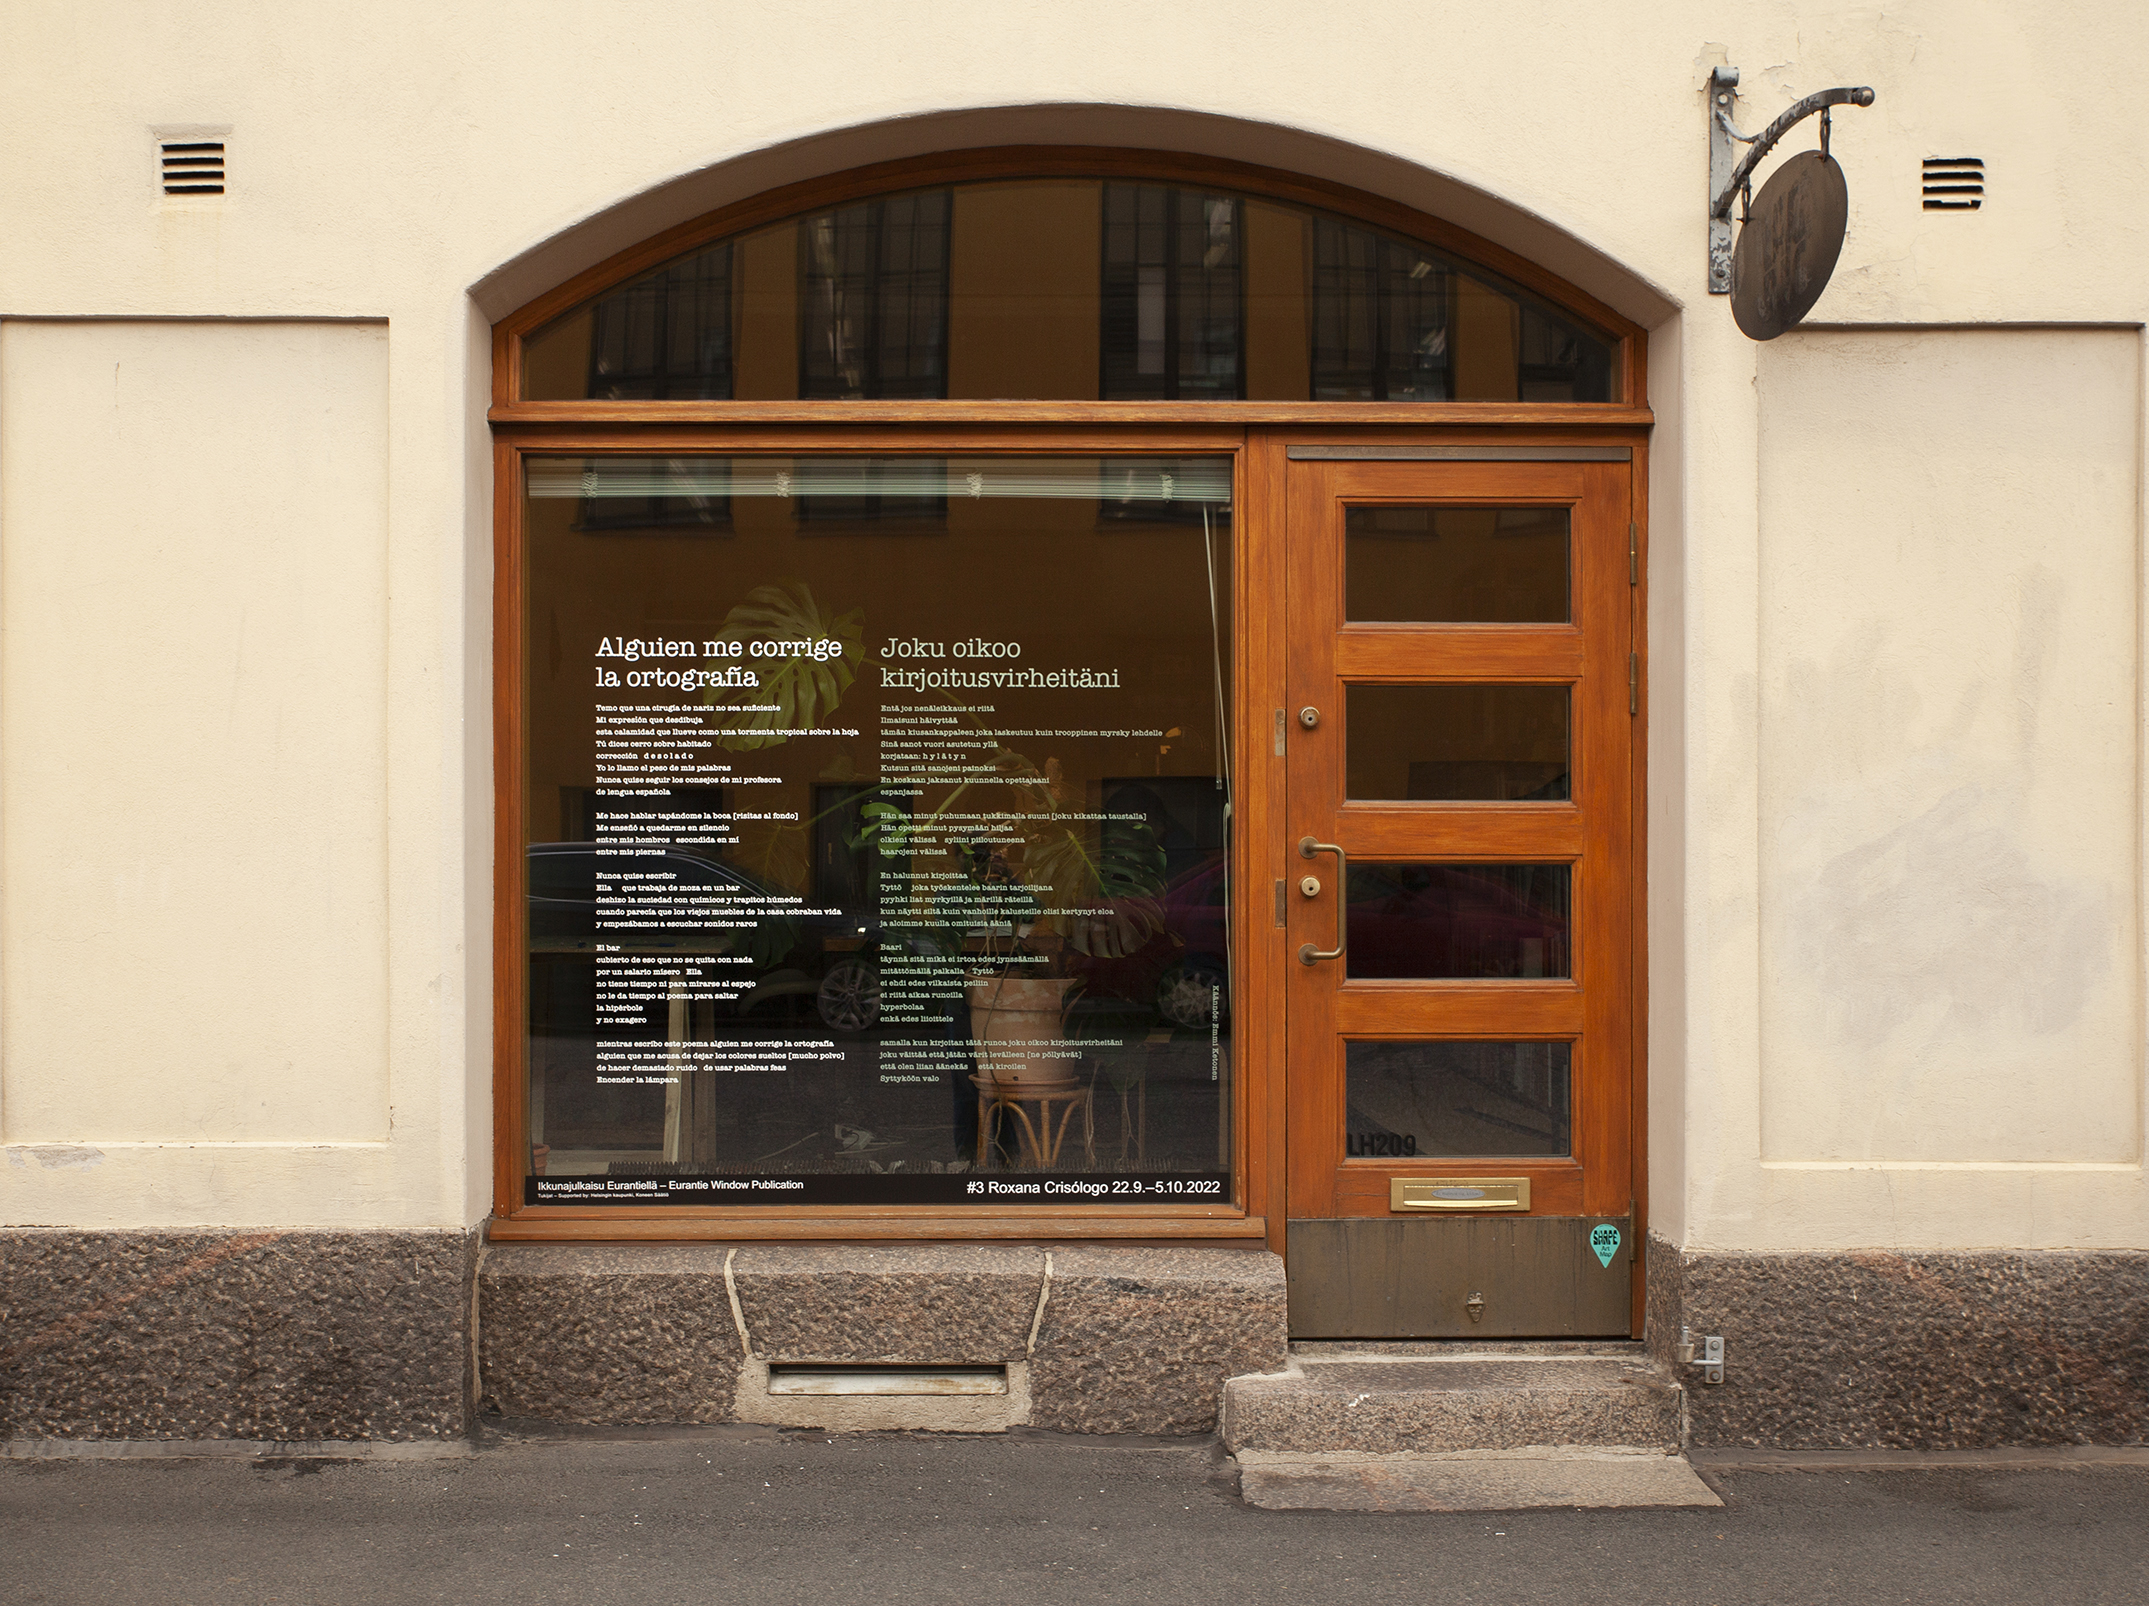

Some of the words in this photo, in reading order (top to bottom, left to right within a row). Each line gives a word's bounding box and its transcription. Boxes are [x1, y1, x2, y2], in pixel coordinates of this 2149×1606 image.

[594, 636, 698, 662] Alguien
[702, 640, 743, 658] me
[749, 636, 843, 662] corrige
[880, 637, 947, 658] Joku
[952, 637, 1021, 658] oikoo
[595, 666, 621, 688] la
[626, 666, 760, 692] ortografía
[880, 667, 1121, 693] kirjoitusvirheitäni
[595, 704, 619, 712] Temo
[618, 705, 634, 713] que
[651, 704, 681, 713] cirugía
[681, 704, 692, 712] de
[692, 704, 715, 712] nariz
[742, 704, 782, 712] suficiente
[880, 704, 900, 712] Entä
[899, 705, 913, 714] jos
[595, 716, 608, 724] Mi
[608, 715, 648, 725] expresión
[648, 717, 664, 725] que
[664, 716, 704, 725] desdibuja
[880, 716, 919, 724] Ilmaisuni
[919, 716, 959, 726] häivyttää
[595, 728, 614, 736] esta
[613, 728, 656, 736] calamidad
[656, 729, 672, 737] que
[672, 728, 697, 736] llueve
[737, 728, 776, 736] tormenta
[775, 728, 808, 737] tropical
[808, 728, 832, 736] sobre
[831, 728, 841, 736] la
[841, 728, 860, 737] hoja
[880, 728, 907, 736] tämän
[974, 728, 994, 738] joka
[994, 728, 1034, 736] laskeutuu
[1054, 729, 1099, 738] trooppinen
[1099, 729, 1131, 738] myrsky
[1131, 729, 1163, 737] lehdelle
[595, 740, 607, 748] Tú
[607, 740, 630, 748] dices
[653, 740, 676, 748] sobre
[676, 740, 712, 748] habitado
[880, 740, 899, 748] Sinä
[982, 740, 999, 750] yllä
[880, 764, 910, 772] Kutsun
[910, 764, 927, 772] sitä
[927, 765, 961, 773] sanojeni
[962, 764, 996, 773] painoksi
[595, 776, 623, 784] Nunca
[622, 776, 645, 785] quise
[645, 776, 672, 785] seguir
[671, 776, 684, 784] los
[684, 776, 720, 785] consejos
[719, 776, 731, 784] de
[731, 776, 743, 784] mi
[743, 776, 783, 785] profesora
[880, 776, 892, 784] En
[892, 776, 927, 784] koskaan
[926, 776, 963, 785] jaksanut
[963, 776, 1004, 784] kuunnella
[595, 788, 606, 796] de
[606, 788, 635, 798] lengua
[635, 788, 672, 797] española
[880, 788, 924, 797] espanjassa
[879, 836, 908, 844] olkieni
[908, 836, 937, 844] välissä
[944, 836, 970, 845] syliini
[595, 848, 619, 856] entre
[619, 848, 635, 856] mis
[635, 848, 666, 857] piernas
[880, 848, 918, 857] haarojeni
[919, 848, 948, 856] välissä
[595, 872, 623, 880] Nunca
[622, 872, 645, 881] quise
[645, 872, 677, 880] escribir
[930, 872, 969, 881] kirjoittaa
[879, 920, 888, 928] ja
[889, 919, 924, 927] aloimme
[924, 919, 951, 927] kuulla
[989, 919, 1013, 928] ääniä
[595, 944, 606, 952] El
[605, 944, 621, 952] bar
[880, 943, 903, 951] Baari
[879, 979, 888, 987] ei
[888, 979, 907, 987] ehdi
[907, 979, 927, 987] edes
[927, 979, 963, 987] vilkaista
[963, 979, 989, 988] peiliin
[879, 991, 888, 999] ei
[889, 991, 907, 999] riitä
[907, 991, 931, 999] aikaa
[931, 991, 964, 999] runoilla
[596, 1004, 605, 1012] la
[605, 1004, 644, 1013] hipérbole
[879, 1003, 925, 1012] hyperbolaa
[595, 1017, 603, 1025] y
[614, 1016, 648, 1025] exagero
[879, 1015, 900, 1023] enkä
[900, 1015, 920, 1023] edes
[920, 1015, 954, 1023] liioittele
[1212, 1022, 1220, 1047] Emmi
[1211, 1047, 1220, 1081] Ketonen
[596, 1076, 636, 1084] Encender
[635, 1076, 645, 1084] la
[645, 1076, 680, 1085] lámpara
[880, 1074, 921, 1084] Syttyköön
[1346, 1132, 1416, 1156] LH209
[538, 1181, 605, 1193] Ikkunajulkaisu
[607, 1180, 658, 1191] Eurantiellä
[668, 1180, 709, 1190] Eurantie
[710, 1180, 750, 1190] Window
[751, 1179, 804, 1190] Publication
[966, 1181, 985, 1194] #3
[988, 1181, 1041, 1194] Roxana
[1044, 1180, 1109, 1197] Crisólogo
[1111, 1180, 1221, 1194] 22.9.–5.10.2022
